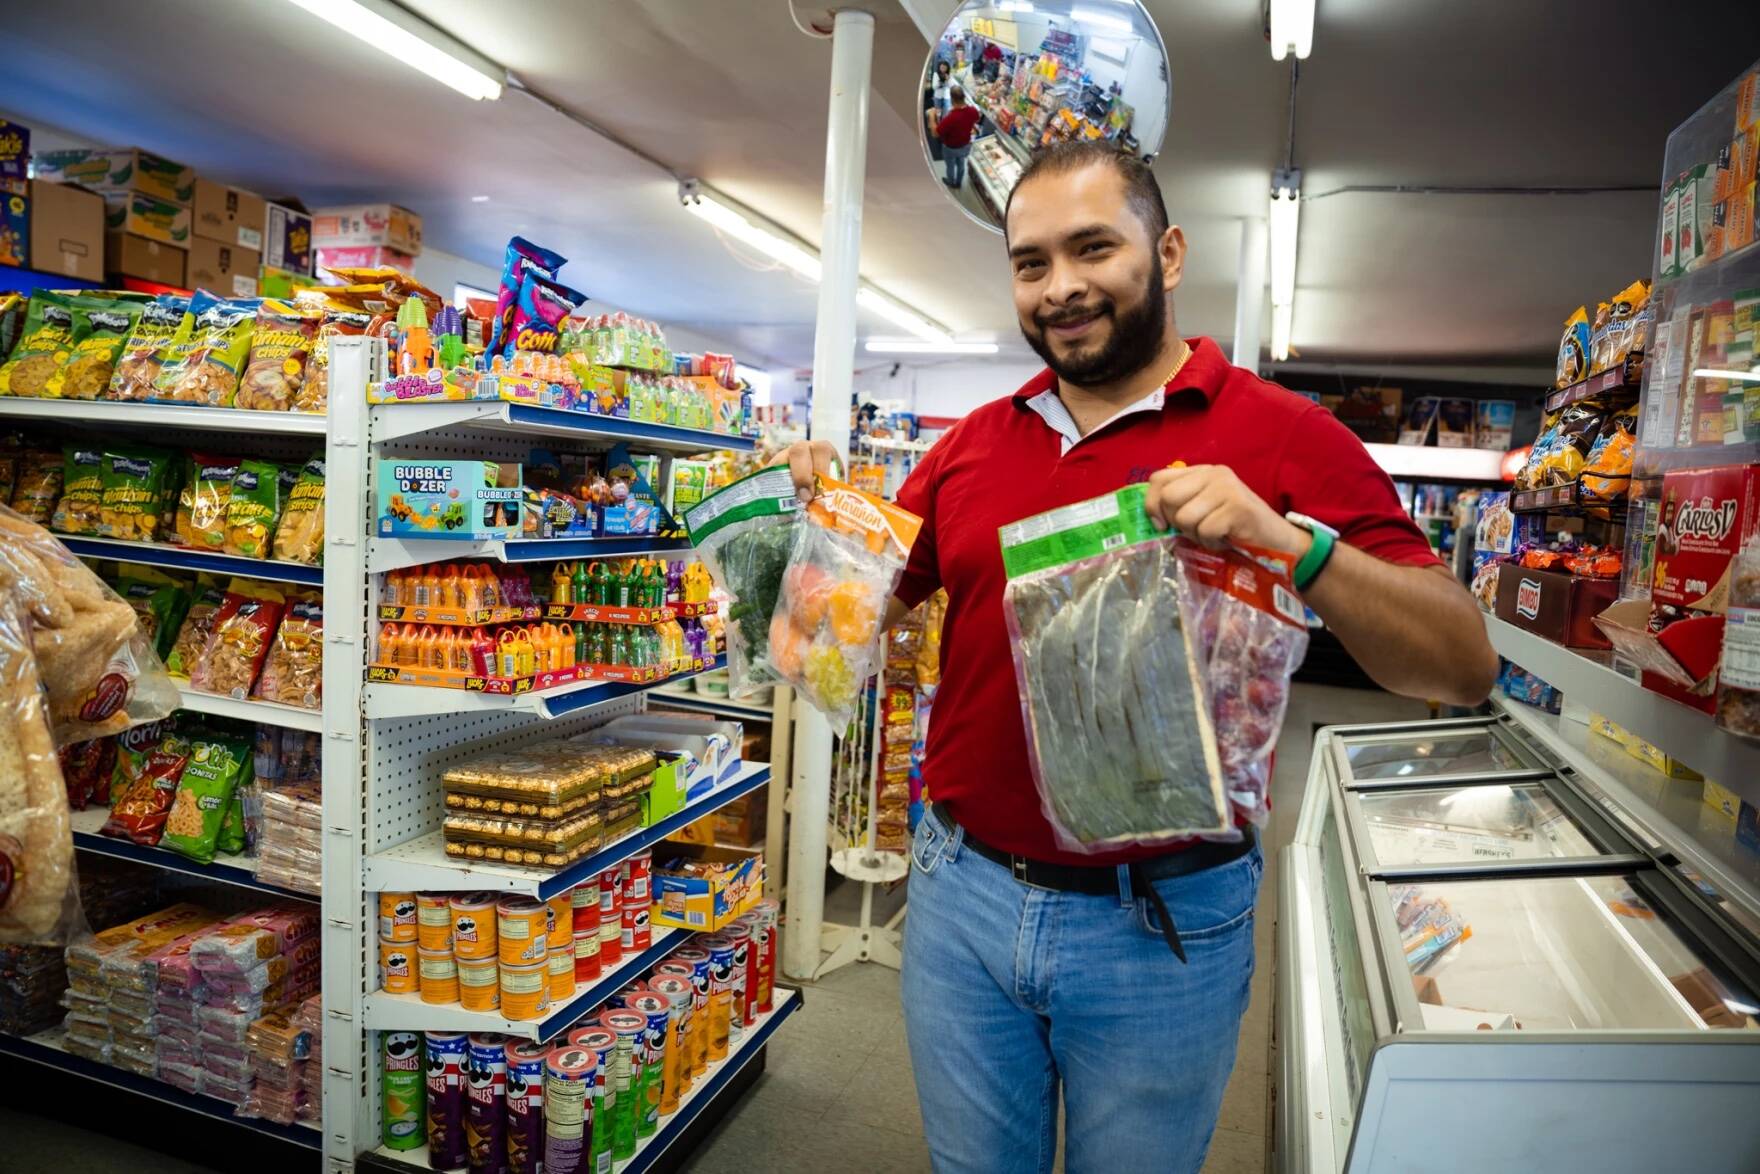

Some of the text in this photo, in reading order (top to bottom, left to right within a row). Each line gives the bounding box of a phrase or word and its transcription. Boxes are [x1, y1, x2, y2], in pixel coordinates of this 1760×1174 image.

[395, 466, 452, 480] BUBBLE
[1519, 587, 1539, 612] BIMBO
[386, 1056, 419, 1071] PRINGLES
